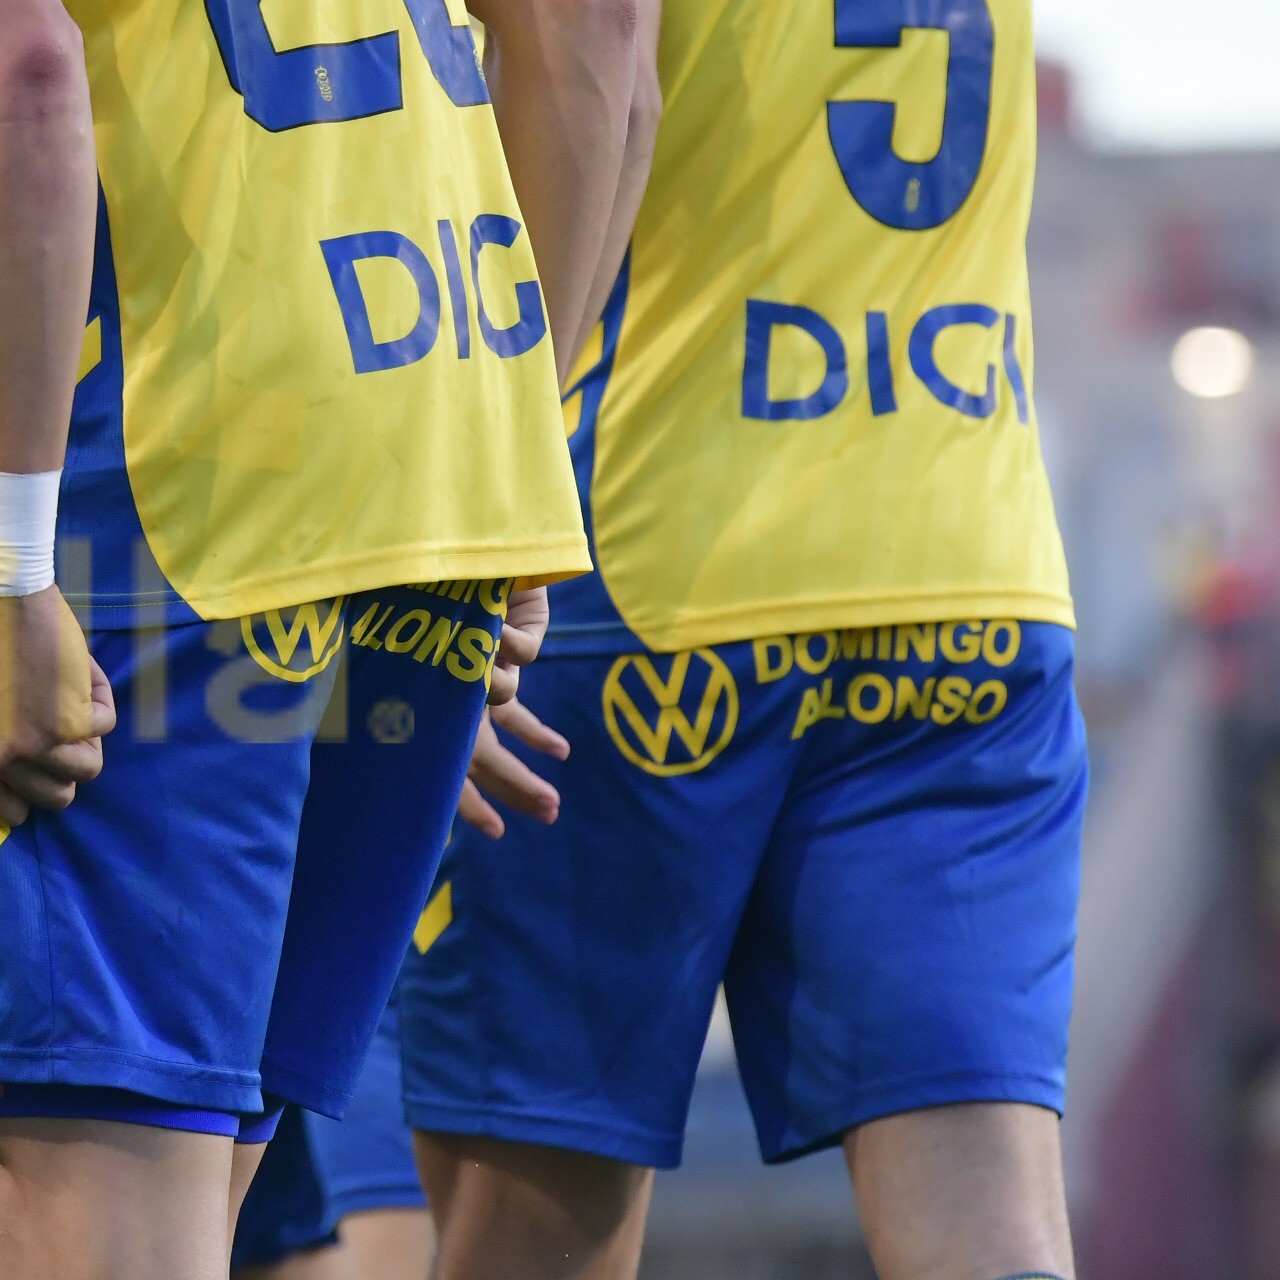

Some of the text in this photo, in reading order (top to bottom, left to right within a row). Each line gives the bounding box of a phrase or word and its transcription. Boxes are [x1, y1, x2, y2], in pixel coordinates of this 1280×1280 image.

[741, 298, 1030, 426] DIGI
[349, 601, 501, 694] ALONS
[752, 619, 1021, 684] DOMINGO
[790, 672, 1008, 741] ALONSO
